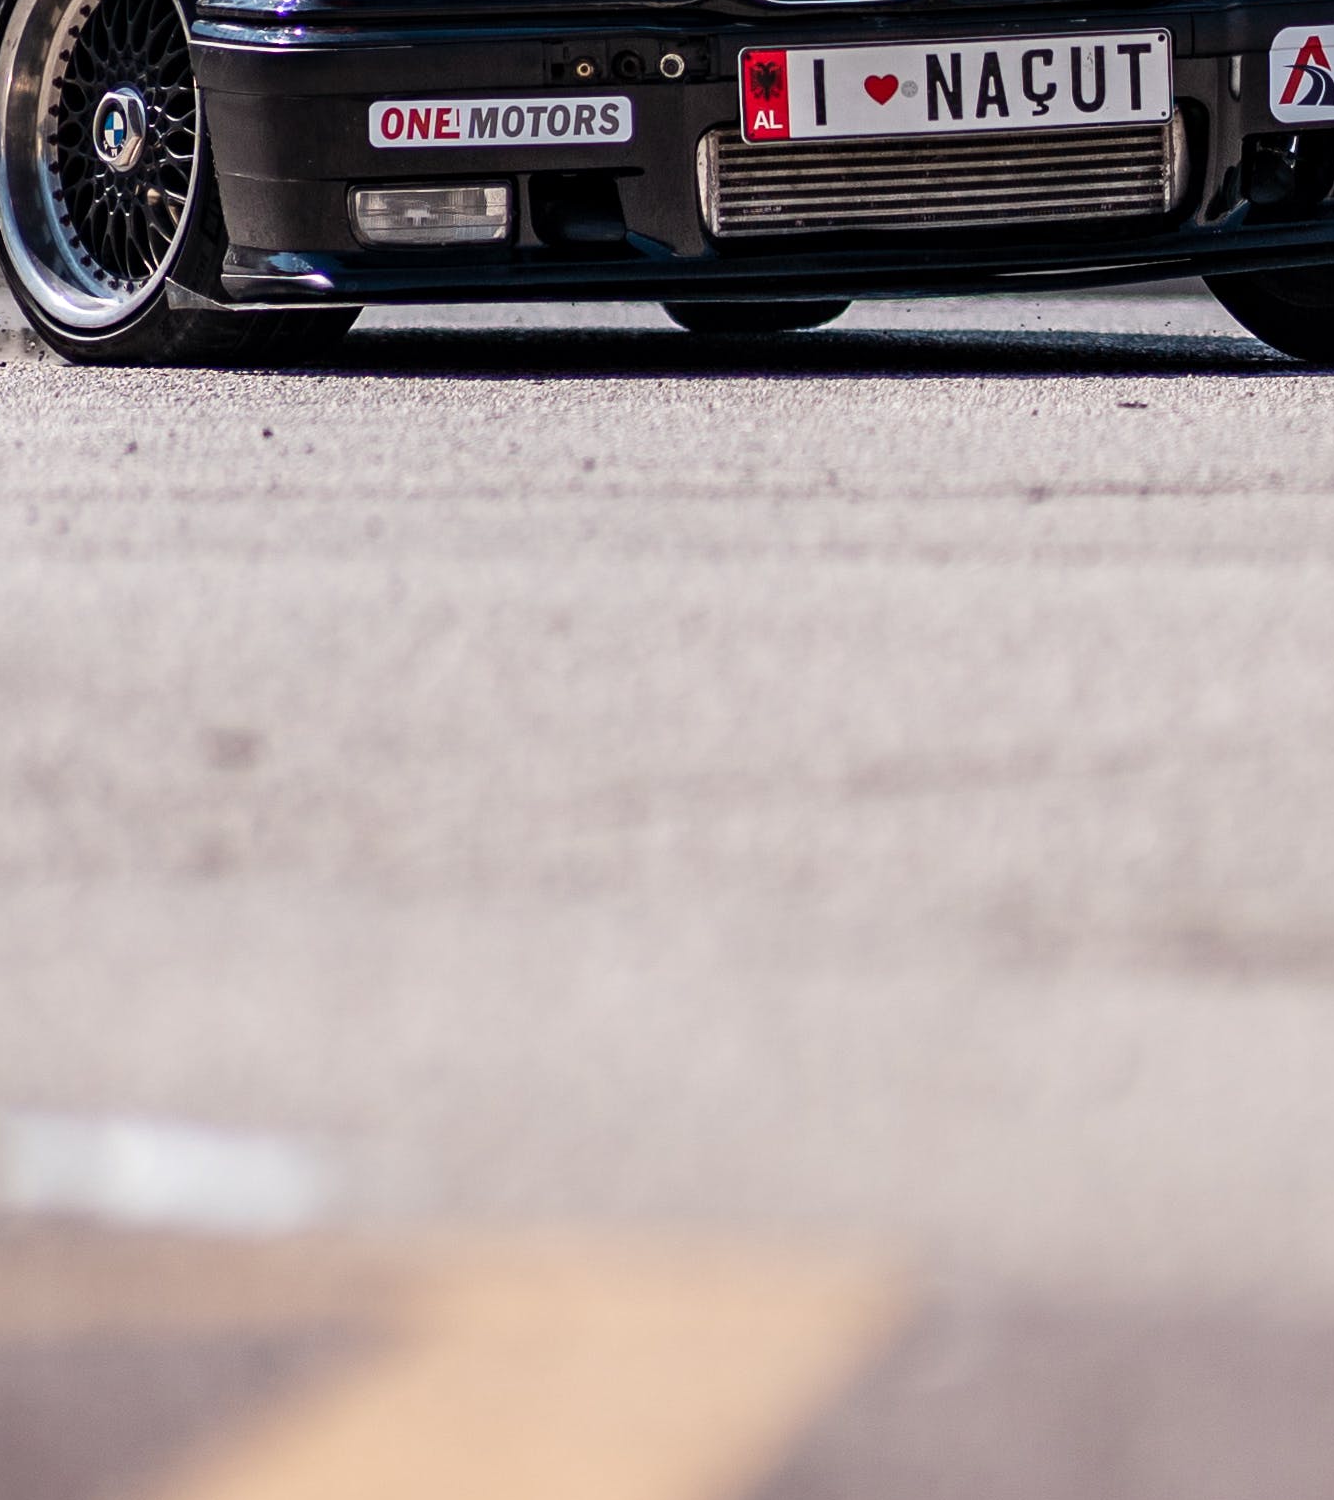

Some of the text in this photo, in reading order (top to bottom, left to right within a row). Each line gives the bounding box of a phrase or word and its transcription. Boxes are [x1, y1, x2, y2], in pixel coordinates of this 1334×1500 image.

[812, 42, 1153, 127] I NAÇUT
[467, 102, 621, 139] MOTORS
[753, 110, 784, 130] AL
